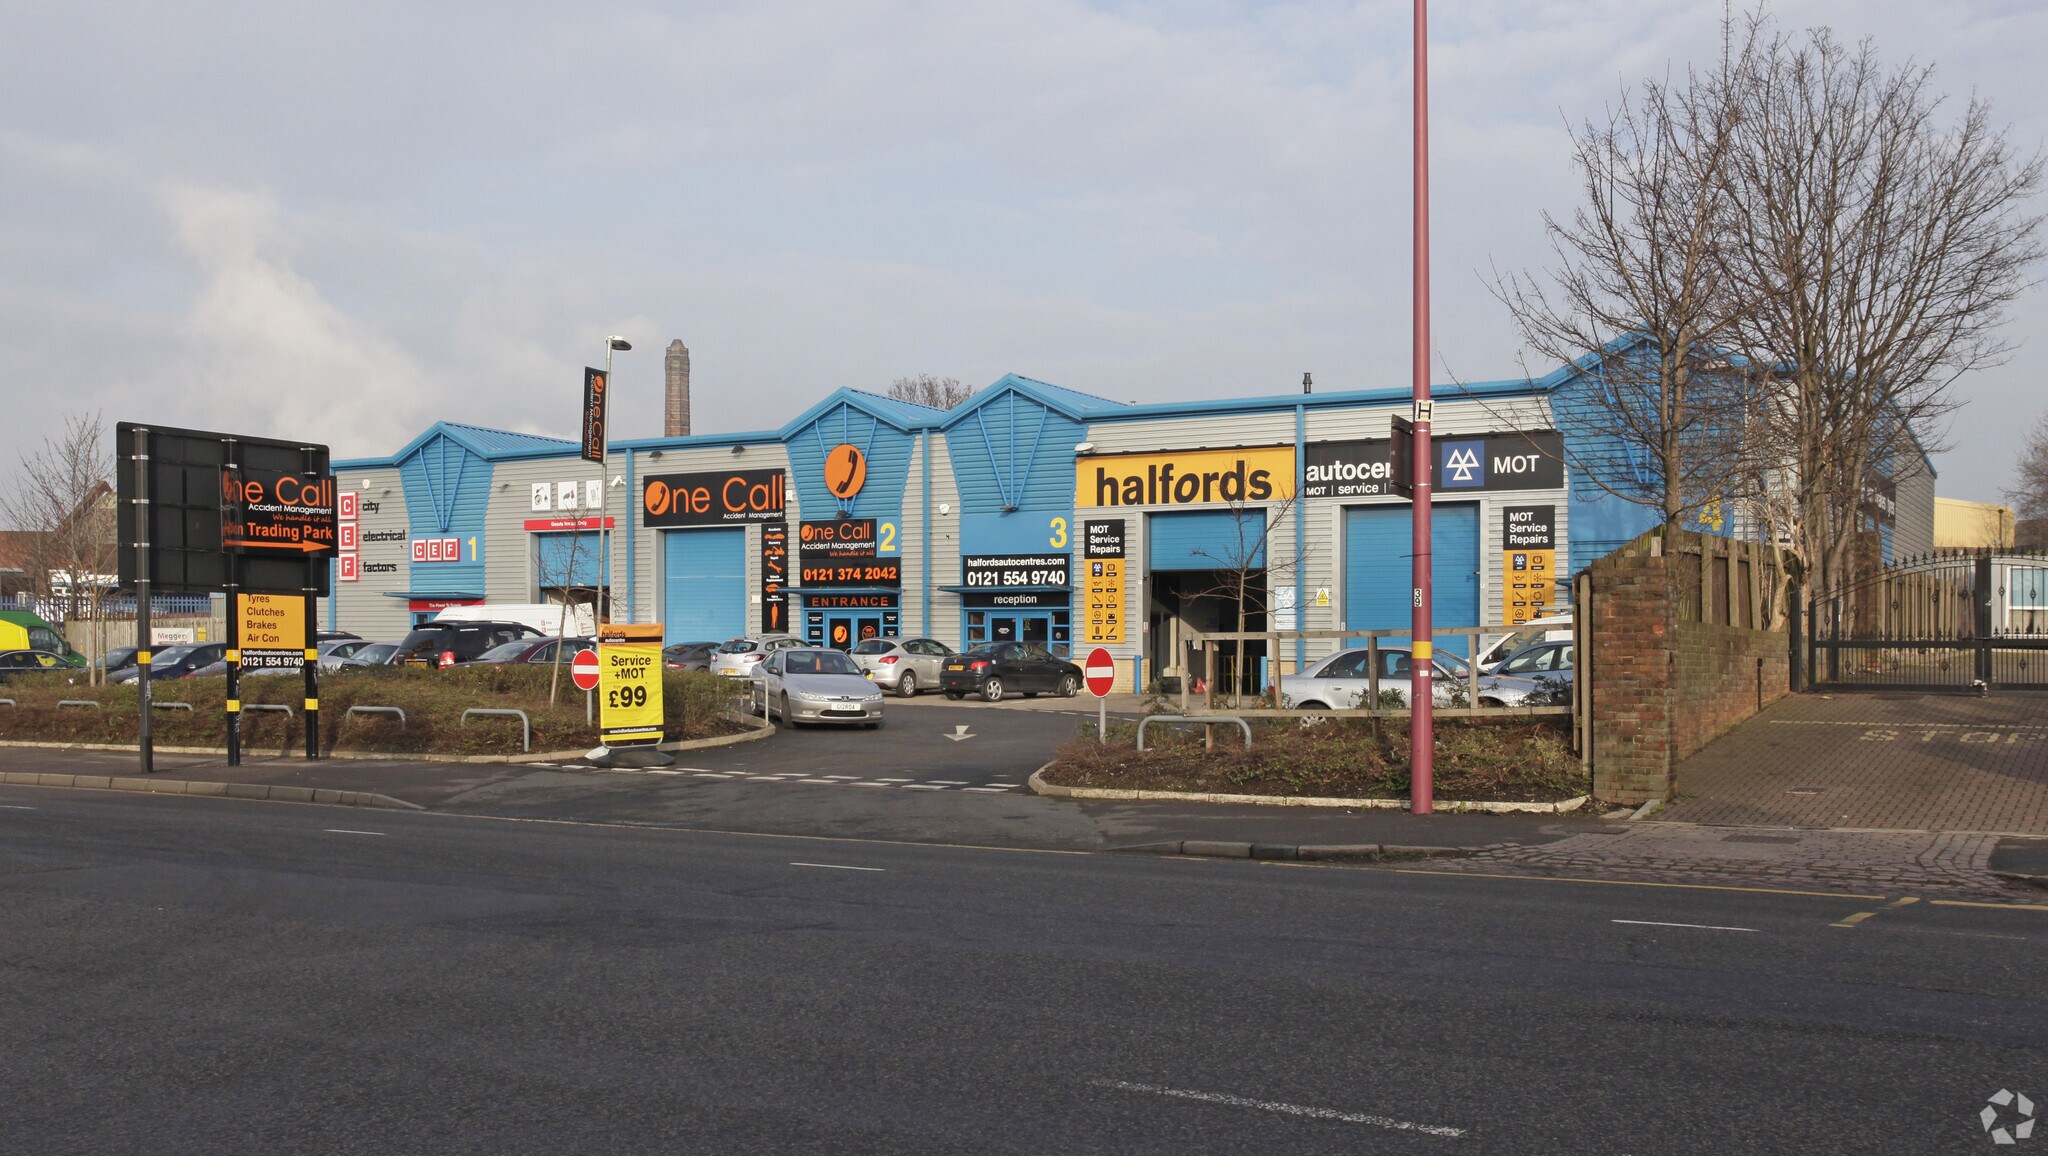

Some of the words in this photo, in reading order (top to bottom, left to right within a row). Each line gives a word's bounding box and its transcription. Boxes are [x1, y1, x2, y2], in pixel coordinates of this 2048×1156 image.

[593, 375, 603, 418] One
[1418, 402, 1431, 419] H
[592, 421, 602, 458] Call
[1493, 455, 1540, 474] MOT
[1096, 460, 1272, 506] halfords
[275, 476, 332, 506] Call
[645, 481, 711, 515] One
[722, 474, 784, 512] Call
[1306, 487, 1326, 496] MOT
[1338, 483, 1379, 494] service
[248, 503, 282, 512] Accident
[284, 505, 332, 515] Management
[362, 500, 380, 514] city
[1699, 495, 1724, 531] 4
[723, 512, 746, 520] Accident
[1509, 512, 1534, 522] MOT
[247, 522, 299, 540] Trading
[303, 525, 333, 539] Park
[800, 524, 834, 542] One
[840, 522, 870, 540] Call
[1050, 517, 1067, 548] 3
[1090, 525, 1109, 534] MOT
[1509, 523, 1547, 533] Service
[363, 530, 406, 542] electrical
[880, 523, 896, 552] 2
[1090, 535, 1120, 544] Service
[1509, 534, 1548, 546] Repairs
[468, 537, 477, 561] 1
[801, 542, 830, 550] Accident
[831, 541, 875, 551] Management
[1090, 544, 1121, 555] Repairs
[363, 562, 397, 573] factors
[968, 558, 1065, 567] halfordsautocentres.com
[803, 569, 833, 580] 0121
[838, 568, 861, 580] 374
[865, 567, 897, 579] 2042
[968, 572, 998, 586] 0121
[1003, 571, 1028, 585] 554
[1031, 570, 1065, 585] 9740
[247, 594, 270, 604] Tyres
[812, 597, 888, 607] ENTRANCE
[994, 594, 1037, 605] reception
[1415, 589, 1421, 606] 39
[247, 606, 285, 616] Clutches
[247, 620, 277, 629] Brakes
[247, 634, 260, 642] Air
[262, 634, 280, 642] Con
[242, 657, 263, 666] 0121
[266, 657, 281, 666] 554
[284, 657, 304, 666] 9740
[611, 655, 651, 666] Service
[615, 668, 645, 680] +MOT
[609, 686, 647, 708] £99
[1859, 730, 2047, 744] STOP
